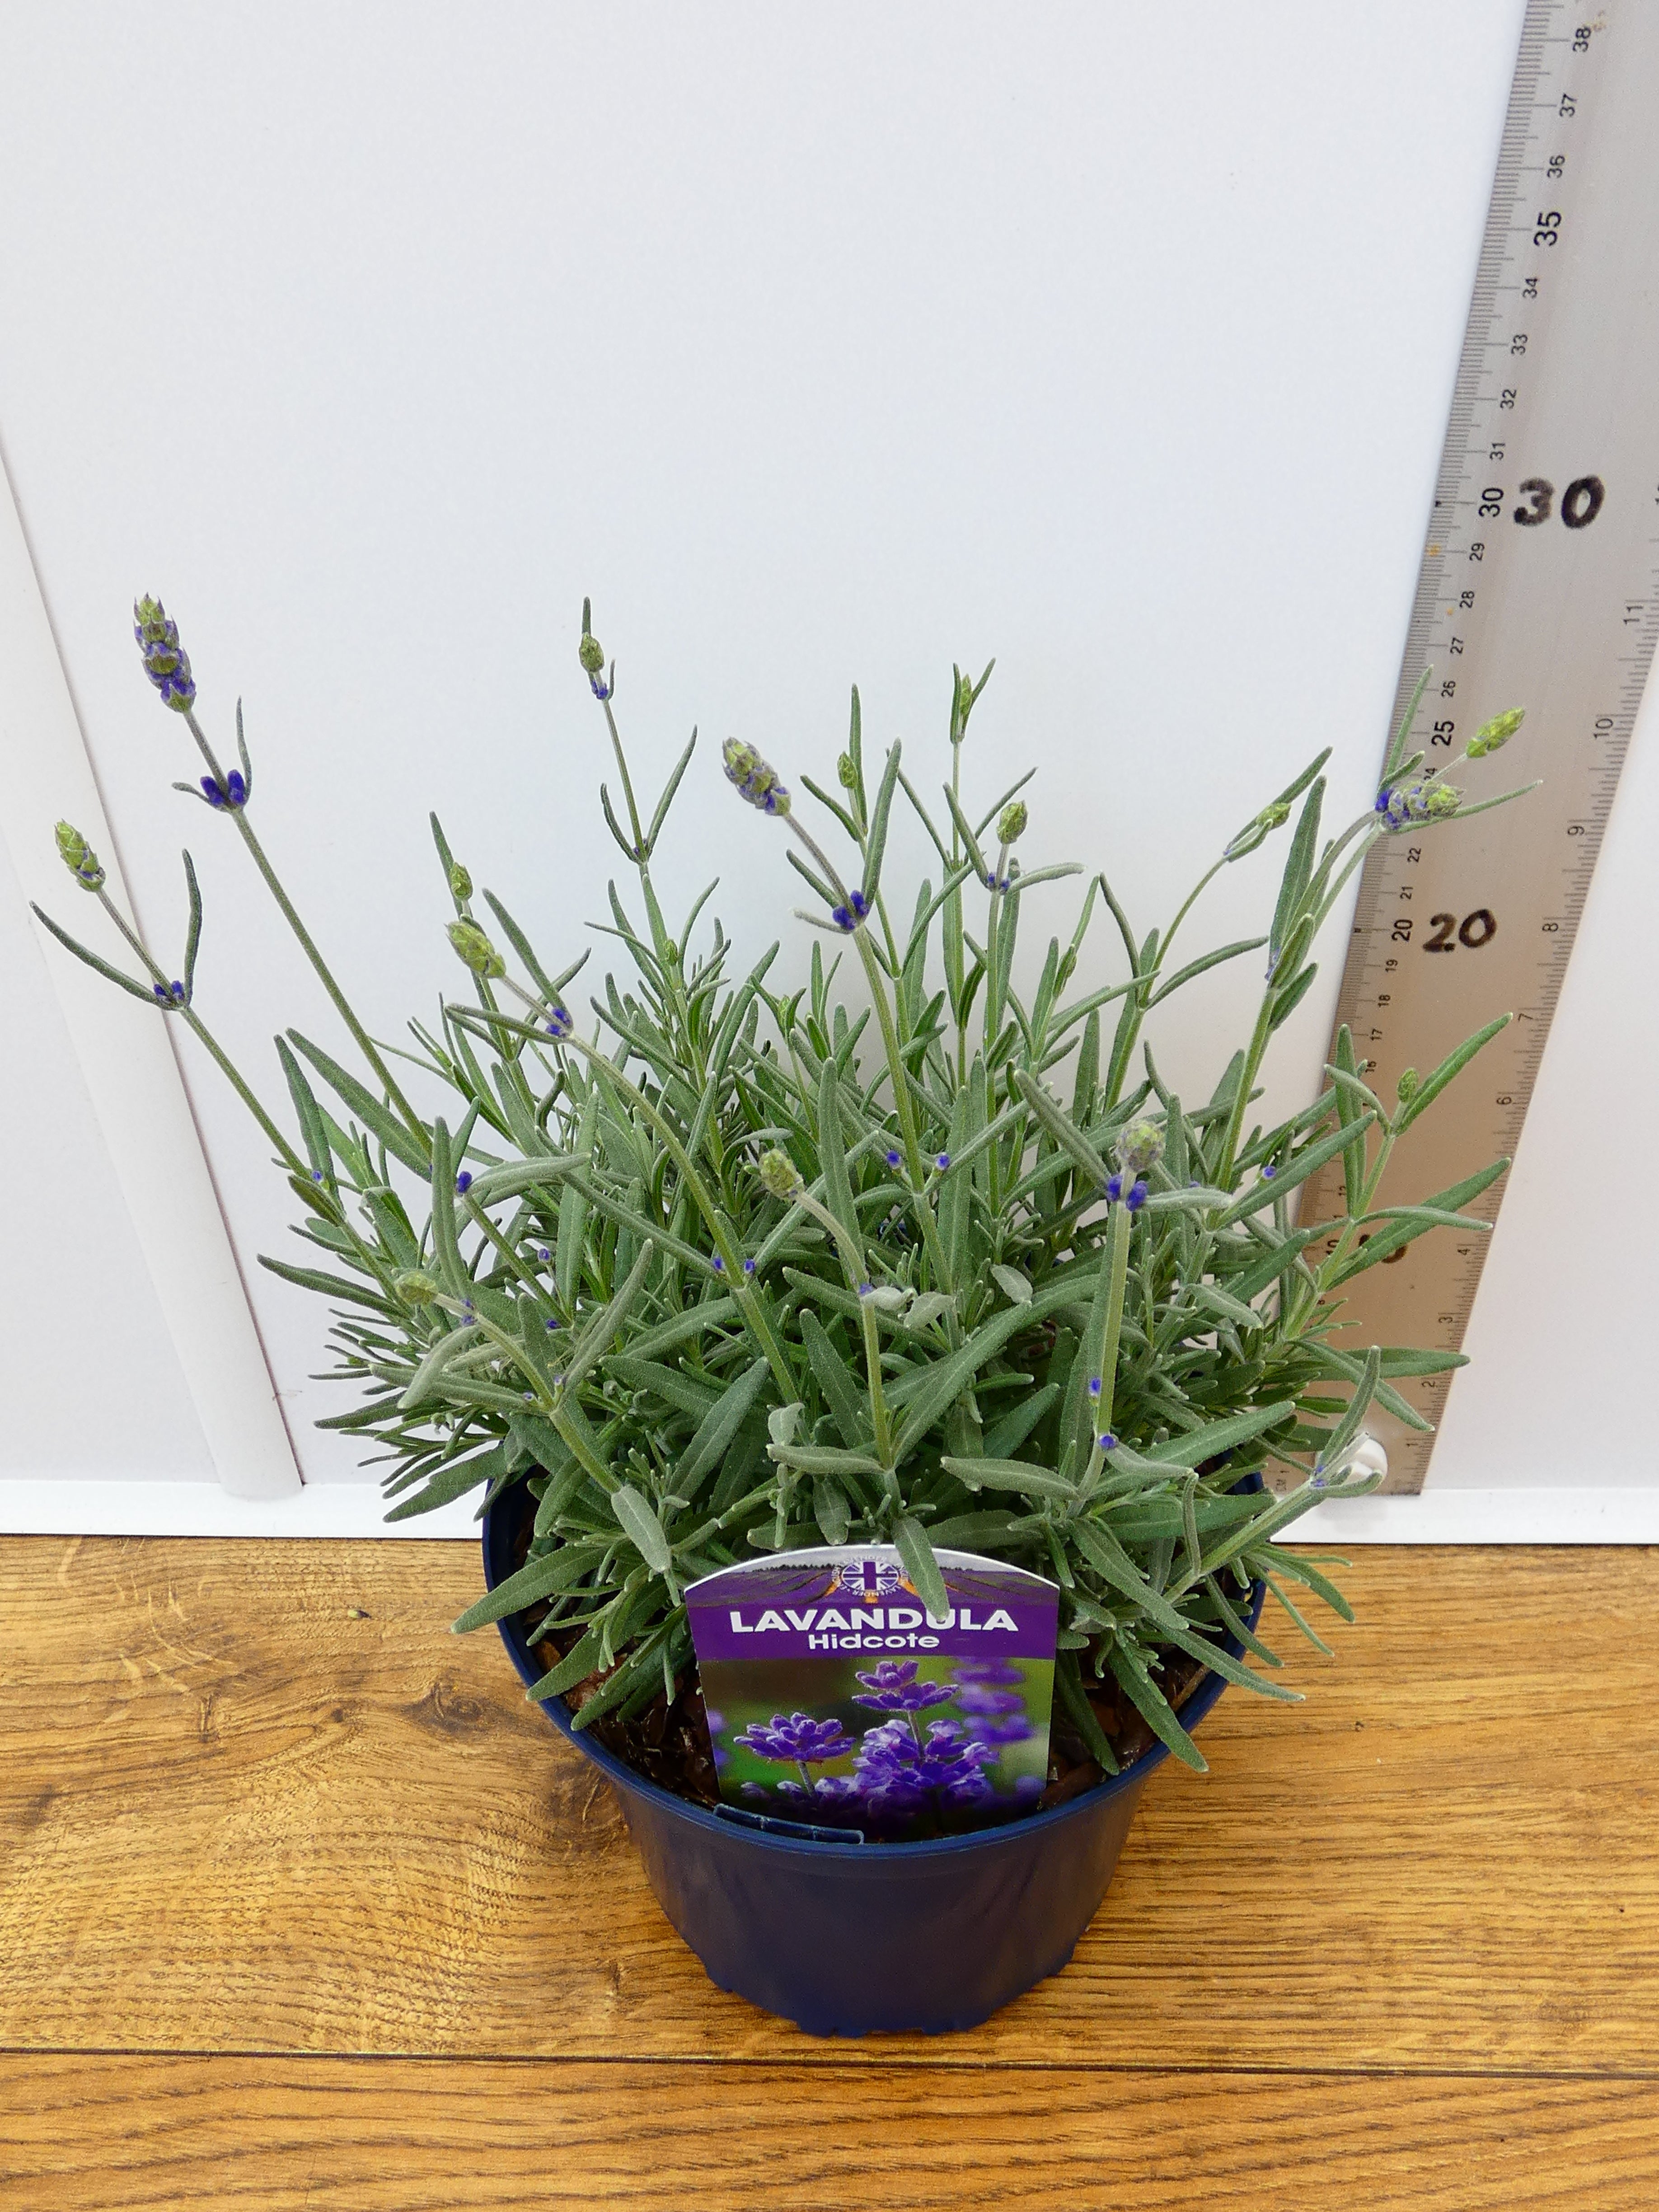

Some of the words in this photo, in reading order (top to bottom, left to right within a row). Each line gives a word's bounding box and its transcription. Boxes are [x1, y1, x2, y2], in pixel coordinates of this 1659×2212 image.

[1572, 26, 1592, 52] 38
[1559, 93, 1578, 118] 37
[1546, 155, 1566, 178] 36
[1533, 211, 1563, 247] 35
[1522, 276, 1540, 299] 34
[1510, 333, 1528, 356] 33
[1499, 389, 1518, 410] 32
[1489, 442, 1506, 461] 31
[1478, 487, 1504, 518] 30
[1513, 475, 1605, 529] 30
[1468, 542, 1486, 562] 29
[1459, 590, 1476, 609] 28
[1622, 605, 1645, 625] 11
[1449, 637, 1464, 655] 27
[1440, 680, 1457, 698] 26
[1430, 721, 1455, 747] 25
[1593, 717, 1614, 740] 10
[1566, 825, 1585, 836] 9
[1406, 847, 1422, 863] 22
[1399, 886, 1414, 900] 21
[1391, 919, 1414, 942] 20
[1422, 908, 1498, 953] 20
[1541, 922, 1559, 933] 8
[1384, 959, 1399, 973] 19
[1377, 994, 1392, 1008] 18
[1517, 1012, 1535, 1022] 7
[1369, 1028, 1383, 1041] 17
[1495, 1096, 1513, 1106] 6
[1457, 1248, 1471, 1256] 4
[1438, 1316, 1454, 1324] 3
[730, 1608, 1018, 1632] LAVANDULA
[808, 1633, 940, 1650] Hidcote
